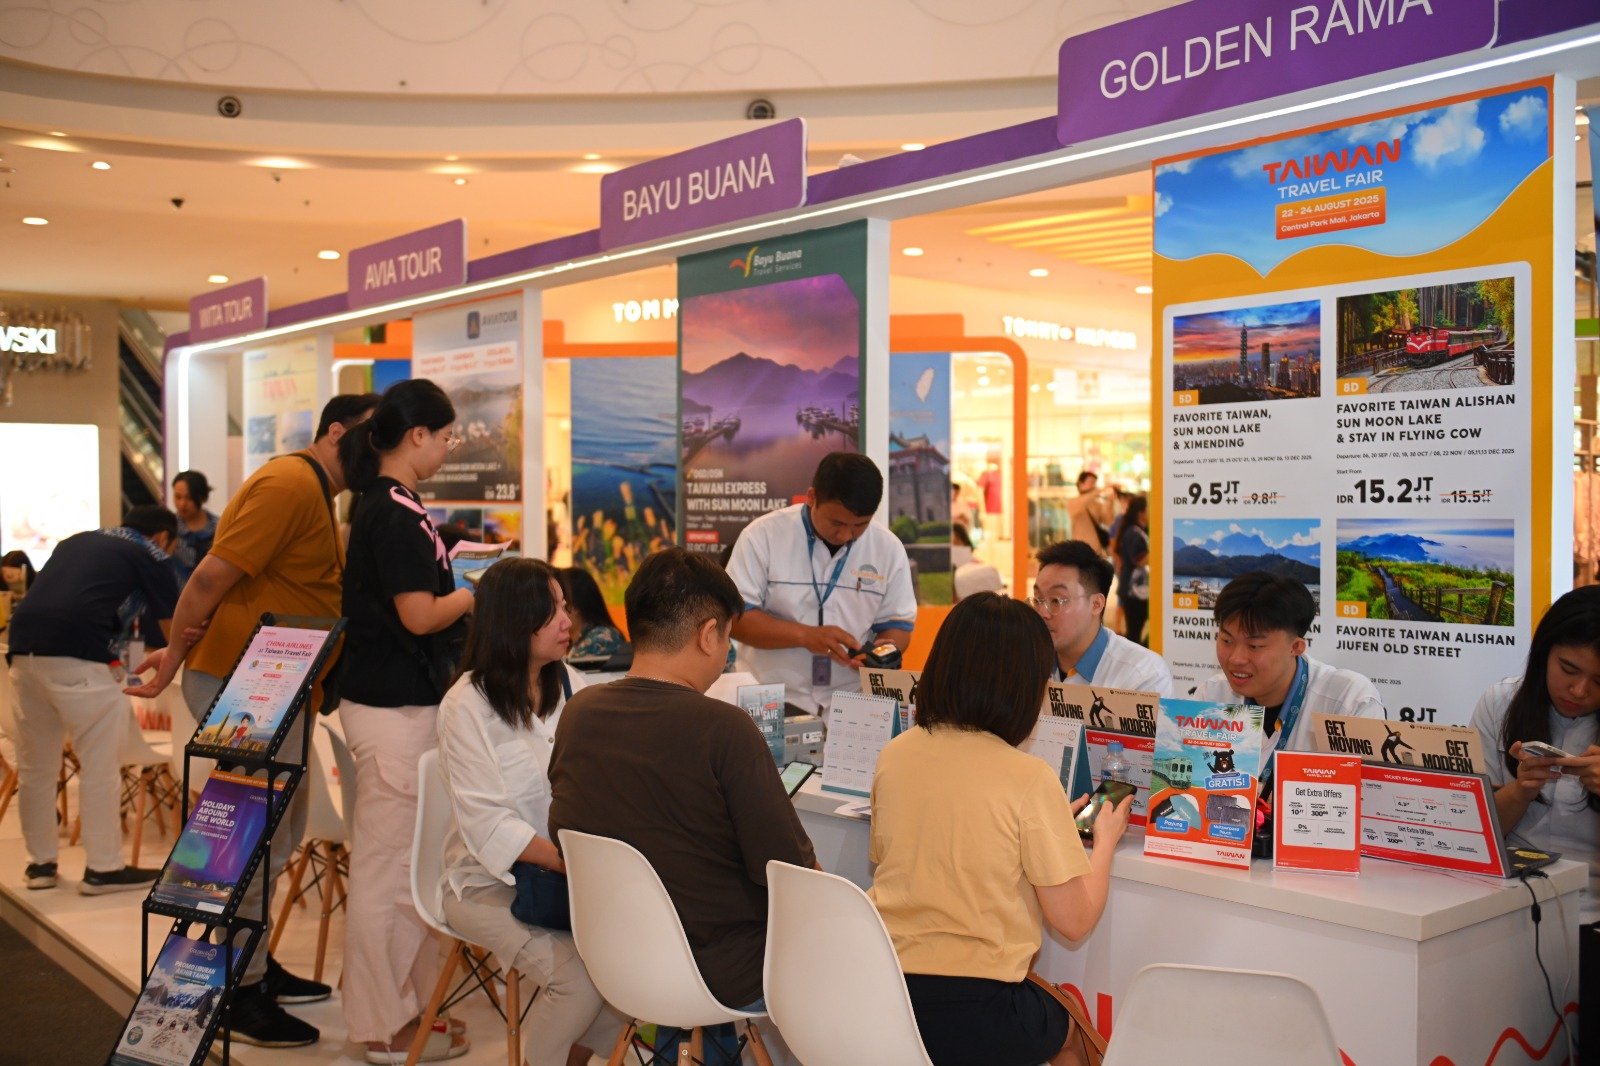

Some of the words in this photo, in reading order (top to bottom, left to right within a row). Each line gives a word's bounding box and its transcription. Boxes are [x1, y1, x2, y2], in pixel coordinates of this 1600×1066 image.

[1099, 16, 1273, 99] GOLDEN
[1290, 0, 1433, 50] RAMA
[1262, 138, 1400, 186] TAIWAN
[623, 176, 682, 222] BAYU
[688, 152, 776, 206] BUANA
[1277, 178, 1341, 199] TRAVEL
[1345, 169, 1384, 188] FAIR
[1281, 209, 1293, 218] 22
[1300, 206, 1313, 215] 24
[1314, 199, 1352, 213] AUGUST
[1353, 194, 1379, 206] 2025
[1281, 222, 1309, 233] Central
[1309, 219, 1328, 228] Park
[1329, 215, 1348, 225] Mall,
[1349, 211, 1380, 222] Jakarta
[753, 254, 774, 268] Bayu
[775, 249, 803, 262] Buana
[364, 258, 397, 291] AVIA
[397, 246, 442, 282] TOUR
[753, 264, 773, 276] Travel
[775, 261, 803, 273] Services
[223, 296, 253, 325] TOUR
[1343, 382, 1359, 393] 8D
[1337, 401, 1396, 414] FAVORITE
[1400, 397, 1450, 411] TAIWAN
[1455, 393, 1515, 408] ALISHAN
[1173, 411, 1223, 423] FAVORITE
[1226, 408, 1272, 420] TAIWAN,
[1336, 418, 1361, 429] SUN
[1365, 416, 1404, 427] MOON
[1408, 413, 1442, 425] LAKE
[1173, 427, 1194, 437] SUN
[1197, 424, 1230, 436] MOON
[1233, 423, 1261, 434] LAKE
[1336, 433, 1345, 444] &
[1349, 432, 1377, 443] STAY
[1381, 431, 1395, 442] IN
[1399, 429, 1446, 442] FLYING
[1450, 427, 1482, 439] COW
[1173, 441, 1180, 451] &
[1183, 438, 1245, 450] XIMENDING
[686, 482, 724, 495] TAIWAN
[724, 481, 767, 495] EXPRESS
[1173, 497, 1188, 505] IDR
[1188, 482, 1223, 505] 9.5
[1223, 480, 1240, 494] JT
[1251, 493, 1269, 505] 9.8
[1336, 495, 1354, 504] IDR
[1354, 478, 1413, 504] 15.2
[1413, 477, 1434, 492] JT
[1450, 490, 1482, 504] 15.5
[686, 498, 710, 511] WITH
[711, 498, 730, 511] SUN
[730, 498, 761, 511] MOON
[761, 498, 788, 511] LAKE
[1343, 604, 1359, 615] 8D
[1173, 615, 1220, 628] FAVORITE
[1173, 629, 1211, 641] TAINAN
[1336, 625, 1396, 638] FAVORITE
[1400, 629, 1450, 642] TAIWAN
[1455, 633, 1515, 646] ALISHAN
[264, 647, 284, 655] Taiwan
[284, 649, 302, 657] Travel
[266, 640, 286, 648] CHINA
[286, 641, 314, 650] AIRLINES
[1336, 640, 1379, 652] JIUFEN
[1383, 643, 1409, 654] OLD
[1413, 645, 1462, 658] STREET
[869, 673, 884, 687] GET
[872, 686, 904, 702] MOVING
[1048, 687, 1064, 702] GET
[1051, 701, 1084, 720] MOVING
[1136, 703, 1154, 720] GET
[1119, 716, 1156, 735] MODERN
[1175, 715, 1244, 733] TAIWAN
[1325, 719, 1346, 737] GET
[1179, 729, 1212, 740] TRAVEL
[1216, 732, 1238, 742] FAIR
[1328, 736, 1374, 756] MOVING
[1445, 739, 1469, 758] GET
[1422, 752, 1474, 774] MODERN
[1302, 767, 1336, 776] TAIWAN
[1208, 778, 1245, 788] GRATIS!
[1295, 787, 1306, 796] Get
[1306, 788, 1323, 797] Extra
[1323, 789, 1342, 799] Offers
[197, 806, 229, 818] AROUND
[201, 799, 236, 812] HOLIDAYS
[195, 813, 210, 822] THE
[210, 816, 235, 828] WORLD
[1216, 850, 1245, 859] TAIWAN
[174, 960, 195, 970] PROMO
